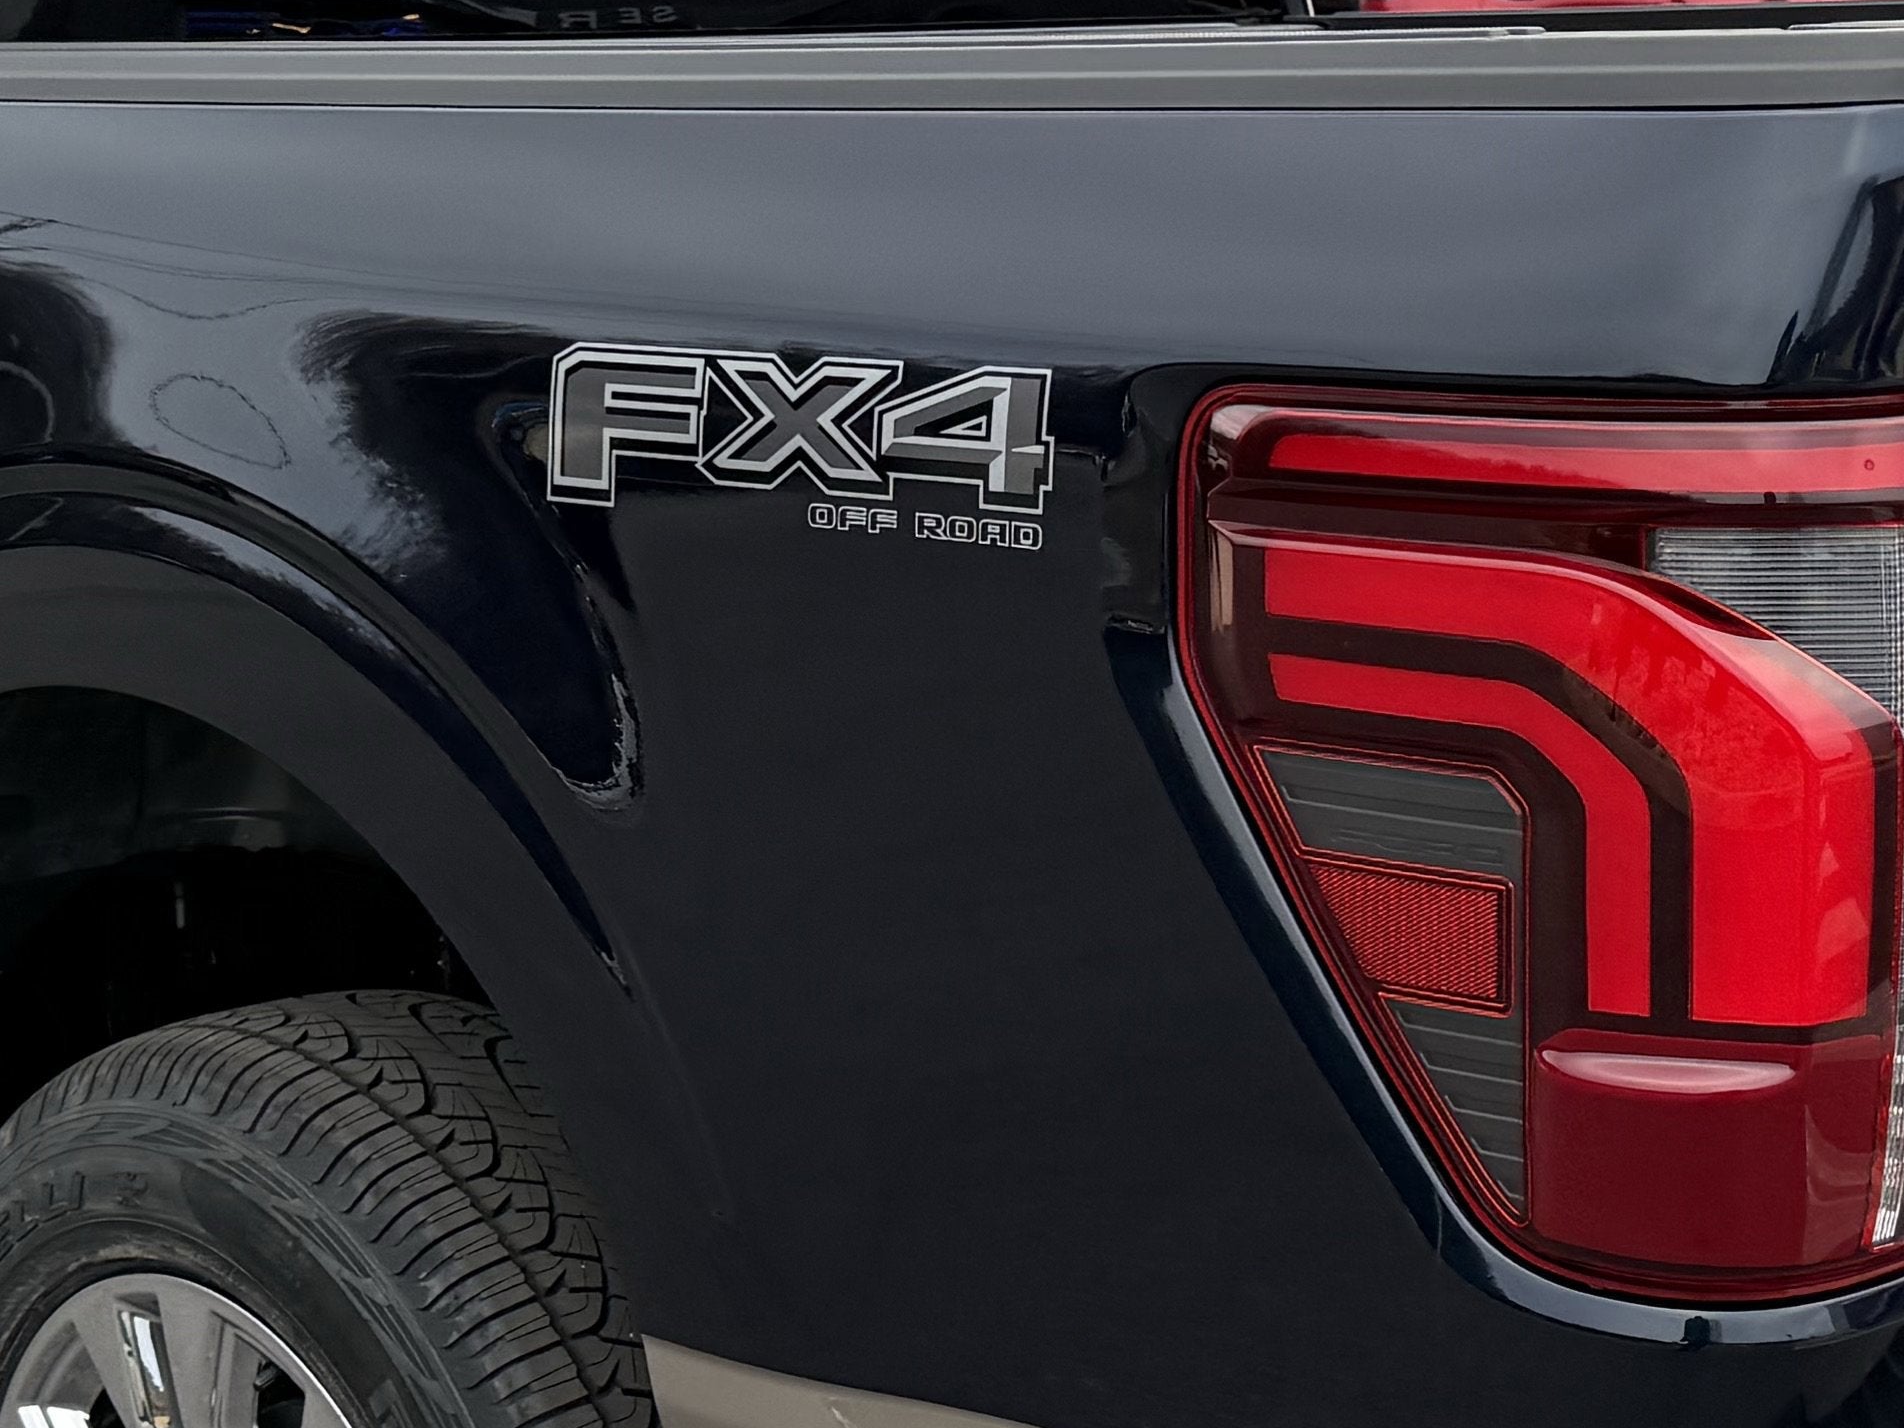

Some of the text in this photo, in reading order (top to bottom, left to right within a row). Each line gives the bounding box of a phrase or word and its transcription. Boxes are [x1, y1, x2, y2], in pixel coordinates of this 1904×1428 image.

[547, 341, 1055, 515] FX4
[807, 502, 1044, 551] OFF ROAD
